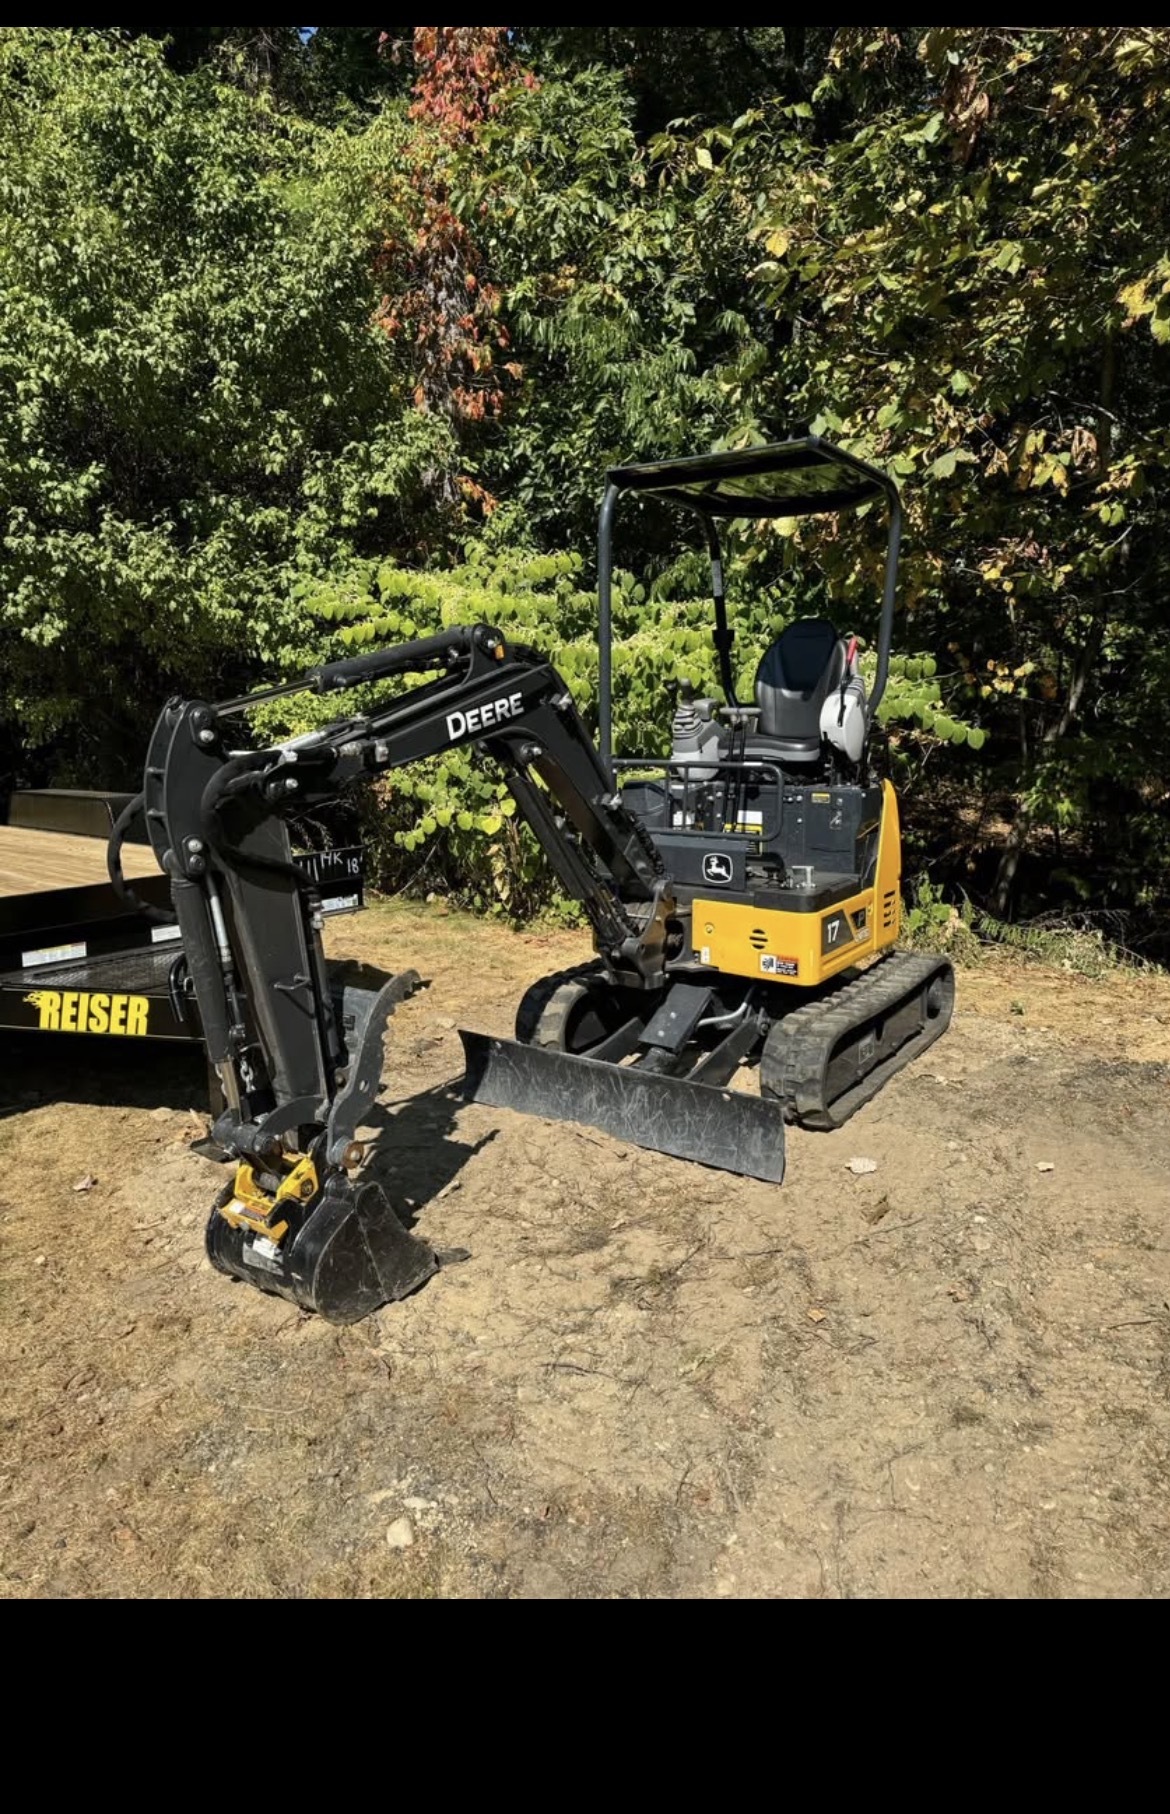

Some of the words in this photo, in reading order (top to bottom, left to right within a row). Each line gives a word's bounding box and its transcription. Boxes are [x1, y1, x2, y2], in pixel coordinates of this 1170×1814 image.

[446, 692, 525, 741] DEERE
[827, 920, 840, 943] 17
[37, 990, 149, 1036] REISER
